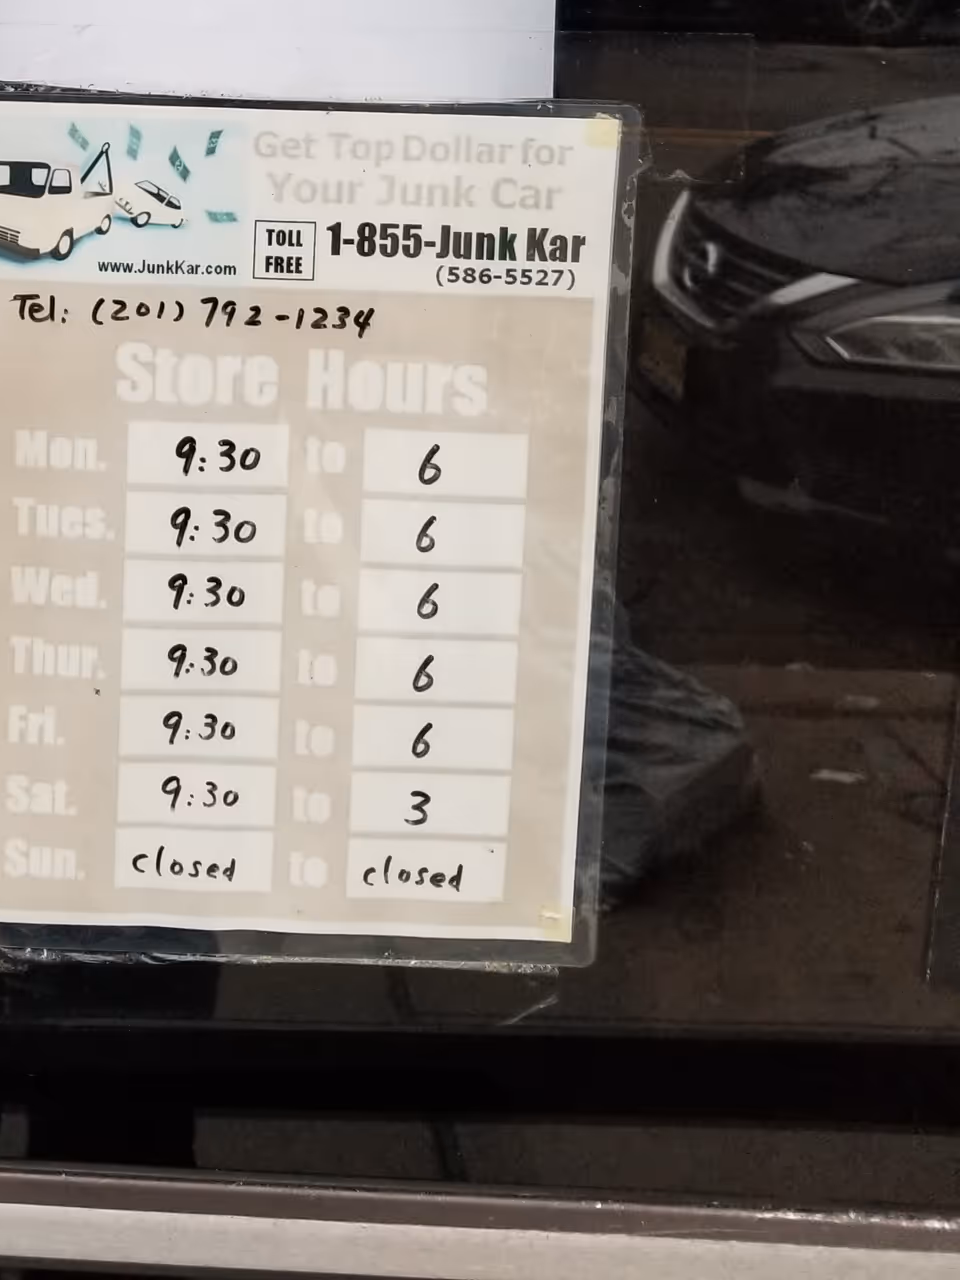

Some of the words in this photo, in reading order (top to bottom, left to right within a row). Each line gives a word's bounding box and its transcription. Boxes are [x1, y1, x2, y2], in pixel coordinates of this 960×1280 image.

[253, 130, 316, 161] Get
[331, 133, 396, 167] Top
[401, 136, 513, 165] Dollar
[519, 139, 575, 167] for
[266, 171, 362, 206] Your
[373, 173, 476, 208] Junk
[490, 178, 563, 211] Car
[265, 228, 303, 248] TOLL
[525, 227, 586, 263] Kar
[97, 259, 237, 276] www.JunkKar.com
[265, 255, 303, 274] FREE
[435, 265, 576, 291] (586-5527)
[11, 293, 69, 324] Tel:
[91, 297, 185, 326] (201)
[115, 341, 279, 406] Store
[307, 348, 489, 416] Hours
[14, 429, 106, 473] Mon.
[175, 435, 261, 477] 9:30
[304, 436, 346, 474] to
[418, 443, 442, 486] 6
[13, 498, 114, 541] Tues.
[170, 506, 257, 548] 9:30
[303, 507, 344, 546] to
[415, 515, 437, 553] 6
[11, 566, 106, 610] Wed.
[167, 572, 246, 610] 9:30
[300, 579, 341, 618] to
[416, 582, 440, 620] 6
[10, 637, 105, 680] Thur.
[167, 643, 238, 678] 9:30
[298, 648, 337, 689] to
[412, 654, 435, 693] 6
[8, 706, 64, 747] Fri.
[162, 710, 236, 745] 9:30
[294, 719, 335, 757] to
[411, 722, 433, 759] 6
[5, 775, 76, 816] Sat.
[161, 775, 240, 810] 9:30
[292, 785, 332, 823] to
[404, 790, 431, 826] 3
[4, 840, 86, 881] Sun.
[131, 845, 236, 882] closed
[288, 850, 327, 888] to
[362, 855, 464, 893] closed
